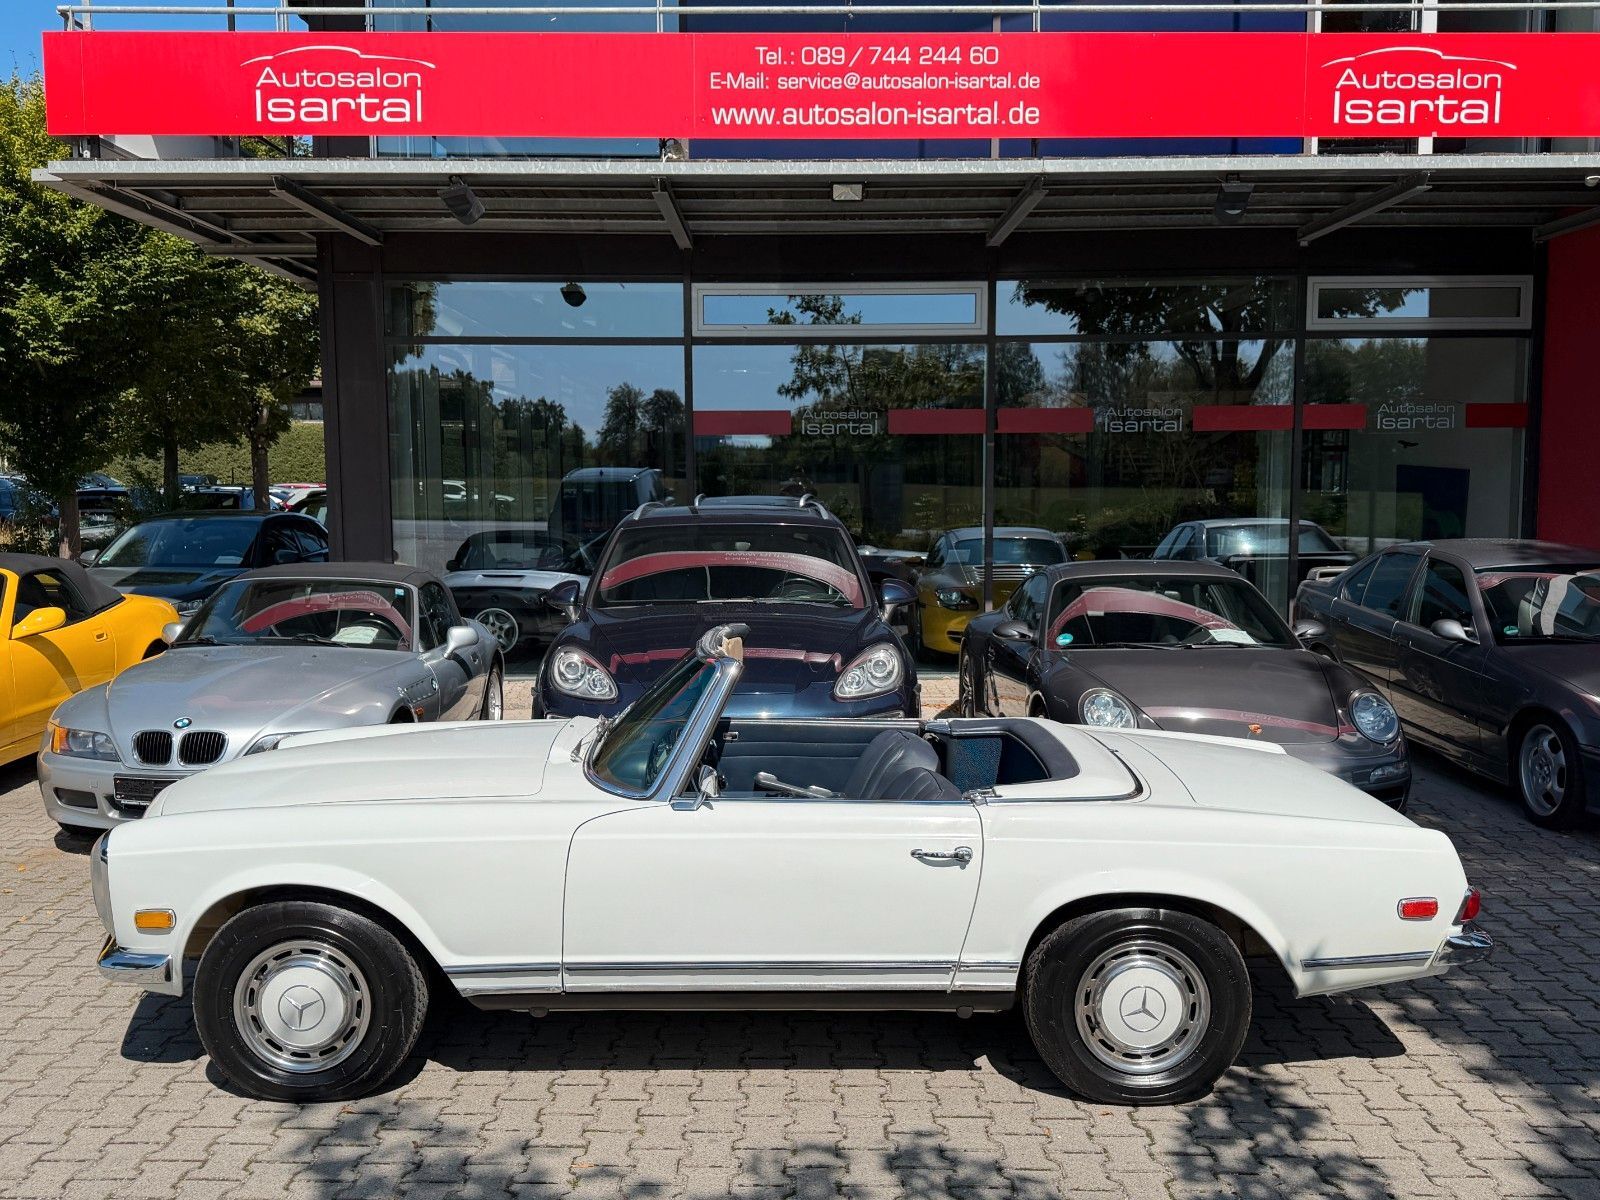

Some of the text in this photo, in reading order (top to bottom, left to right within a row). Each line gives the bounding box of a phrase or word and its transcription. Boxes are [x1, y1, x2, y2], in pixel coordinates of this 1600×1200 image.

[754, 46, 999, 68] Tel.: 089 / 744 244 60
[256, 66, 422, 88] Autosalon
[710, 72, 1041, 90] E-Mail: service@autosalon-isartal.de
[1336, 68, 1502, 90] Autosalon
[255, 89, 422, 123] Isartal
[711, 100, 1040, 126] www.autosalon-isartal.de
[1334, 90, 1501, 124] Isartal
[802, 409, 878, 419] Autosalon
[1105, 407, 1183, 417] Autosalon
[1377, 403, 1455, 413] Autosalon
[802, 419, 878, 435] Isartal
[1104, 416, 1183, 433] Isartal
[1377, 414, 1455, 429] Isartal
